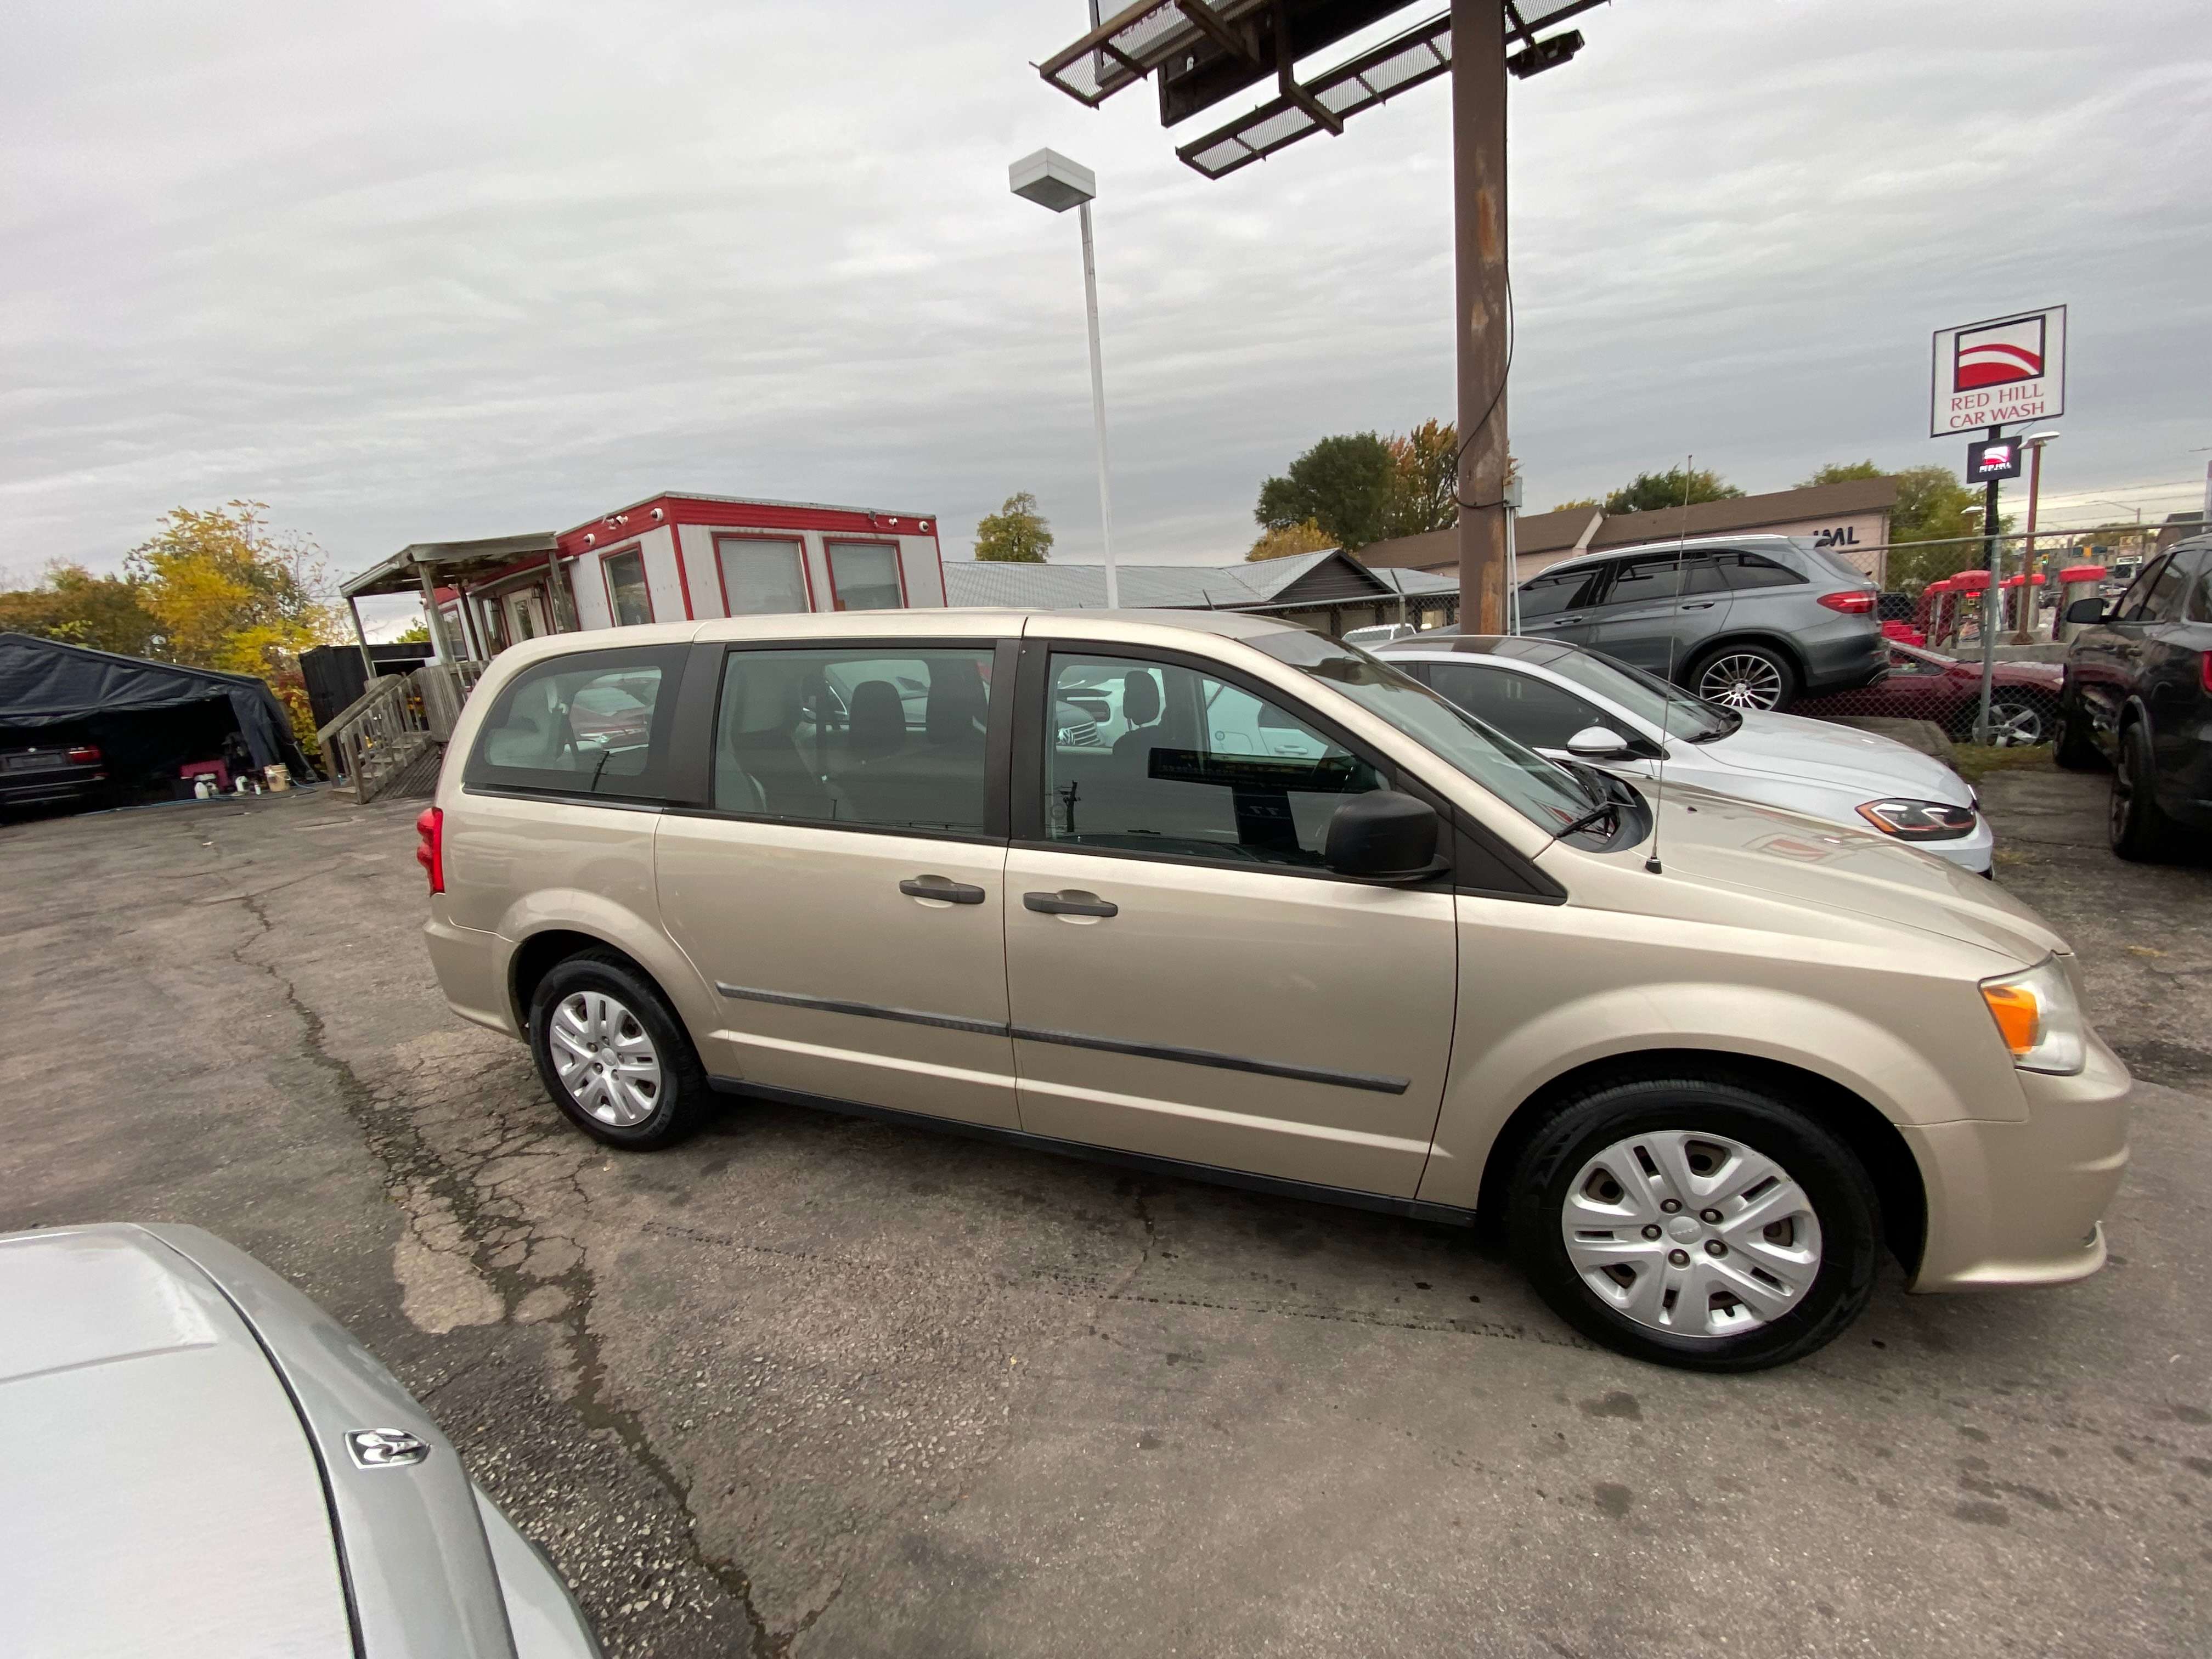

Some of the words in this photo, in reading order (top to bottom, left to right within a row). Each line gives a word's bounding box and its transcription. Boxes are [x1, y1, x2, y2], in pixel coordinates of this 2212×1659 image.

[1951, 393, 1990, 412] RED
[1999, 384, 2044, 403] HILL
[1950, 411, 1984, 428] CAR
[1991, 401, 2044, 421] WASH
[1813, 526, 1860, 547] ML
